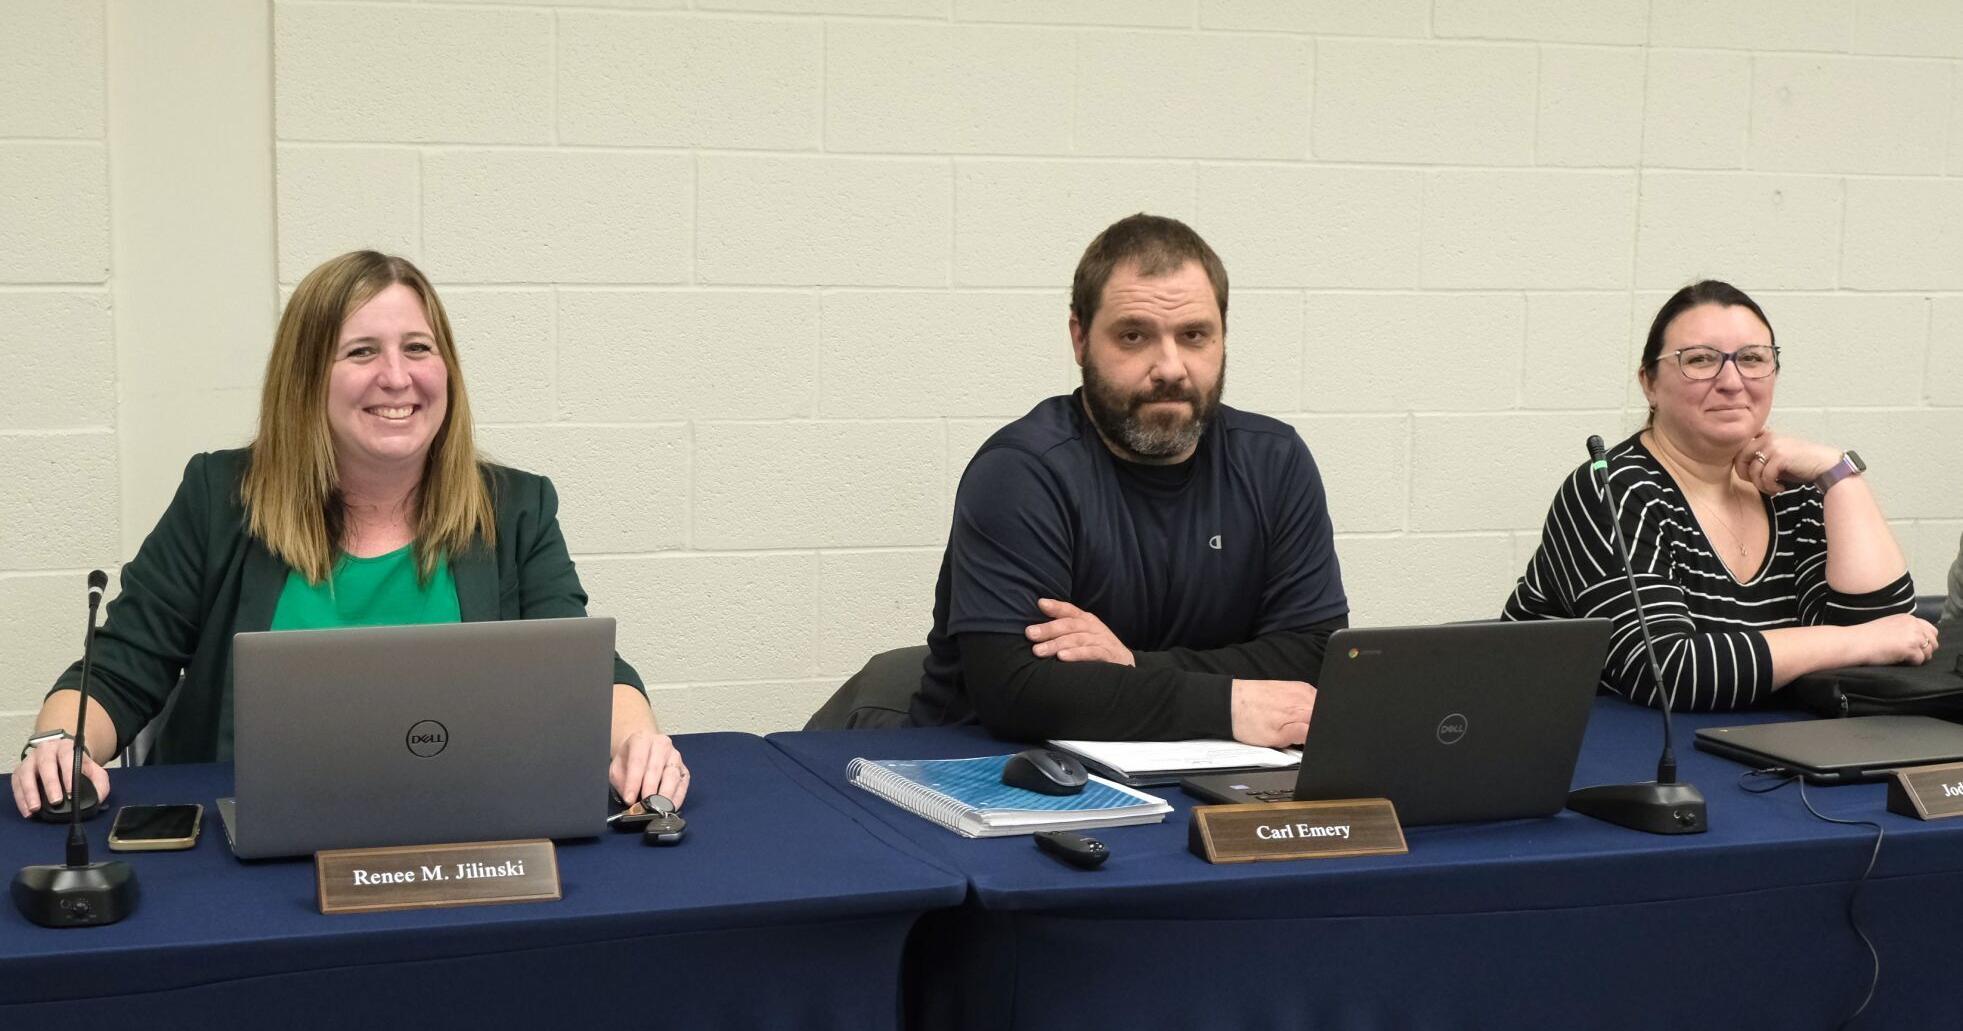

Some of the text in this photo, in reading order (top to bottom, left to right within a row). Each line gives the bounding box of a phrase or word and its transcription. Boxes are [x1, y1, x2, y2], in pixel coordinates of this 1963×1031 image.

[411, 734, 445, 744] DELL
[1256, 823, 1350, 840] Carl Emery
[353, 860, 526, 886] Renee M. Jilinski
